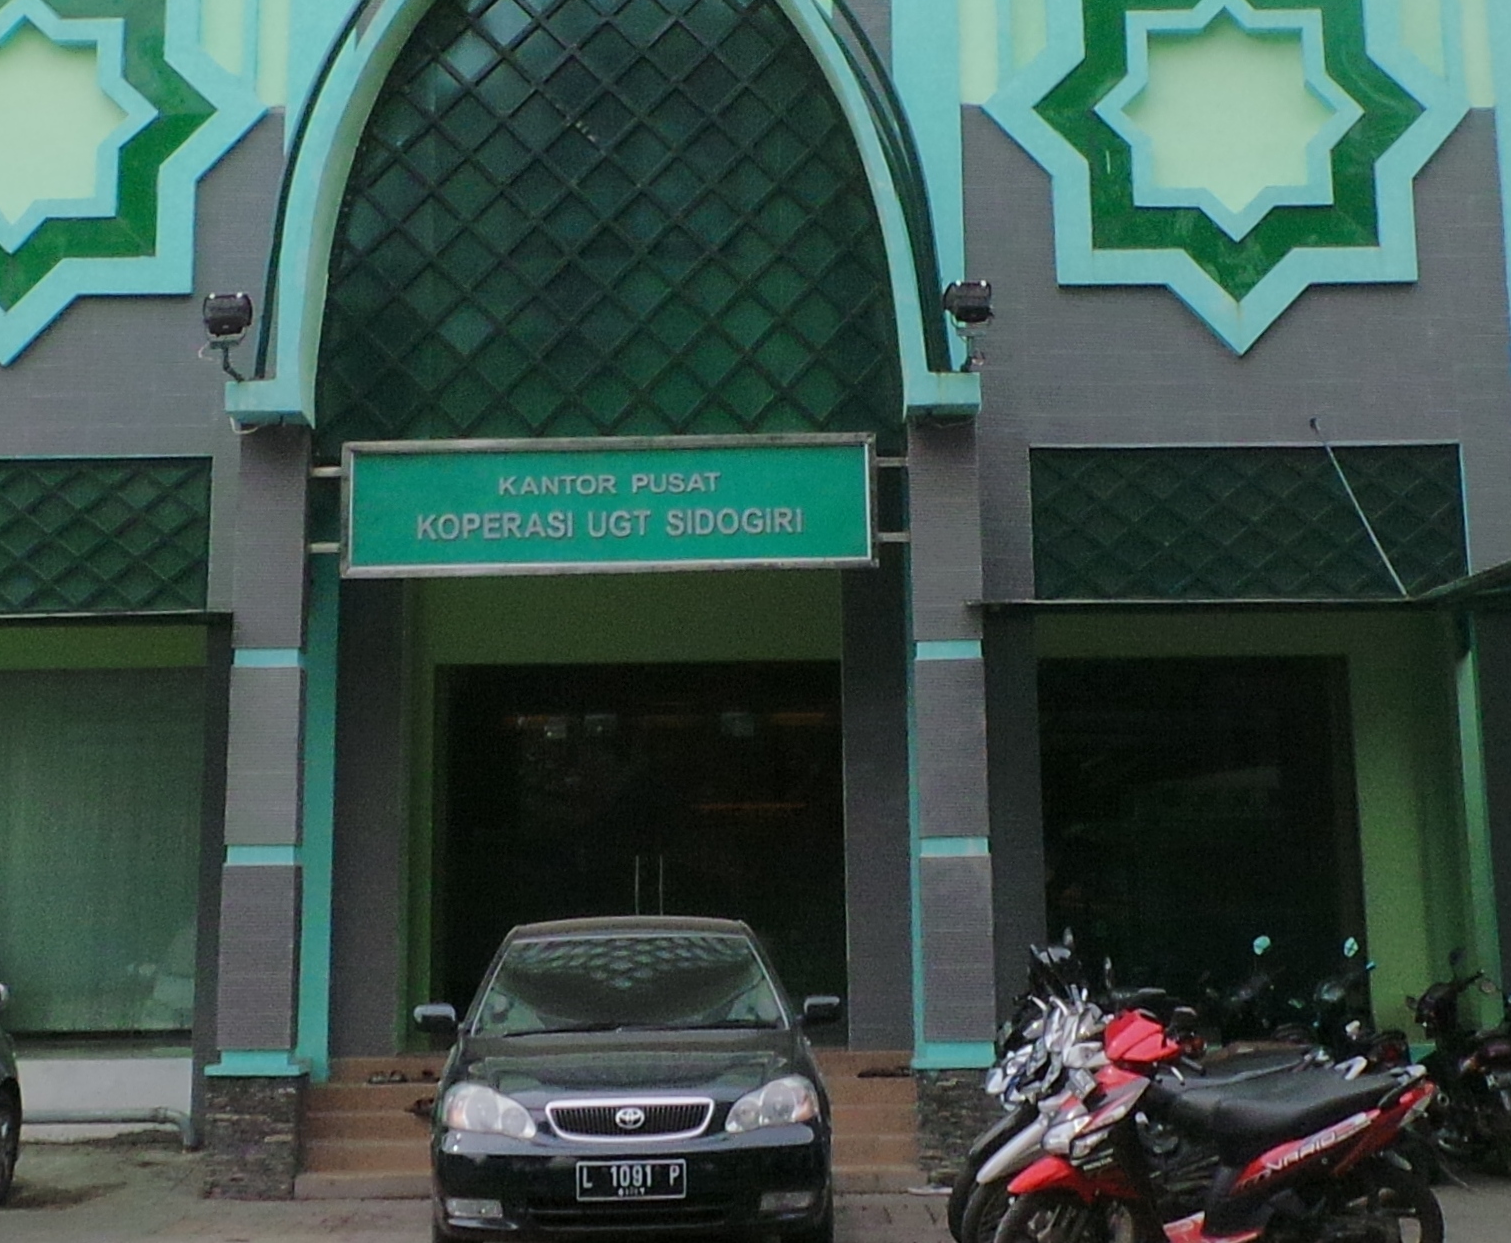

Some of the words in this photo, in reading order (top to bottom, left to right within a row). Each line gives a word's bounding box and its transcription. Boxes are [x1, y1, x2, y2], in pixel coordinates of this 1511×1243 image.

[498, 476, 617, 496] KANTOR
[631, 472, 721, 494] PUSAT
[416, 510, 574, 540] KOPERASI
[587, 509, 651, 538] UGT
[665, 507, 804, 536] SIDOGIRI
[582, 1166, 593, 1189] L
[610, 1164, 652, 1188] 1091
[669, 1164, 680, 1187] P
